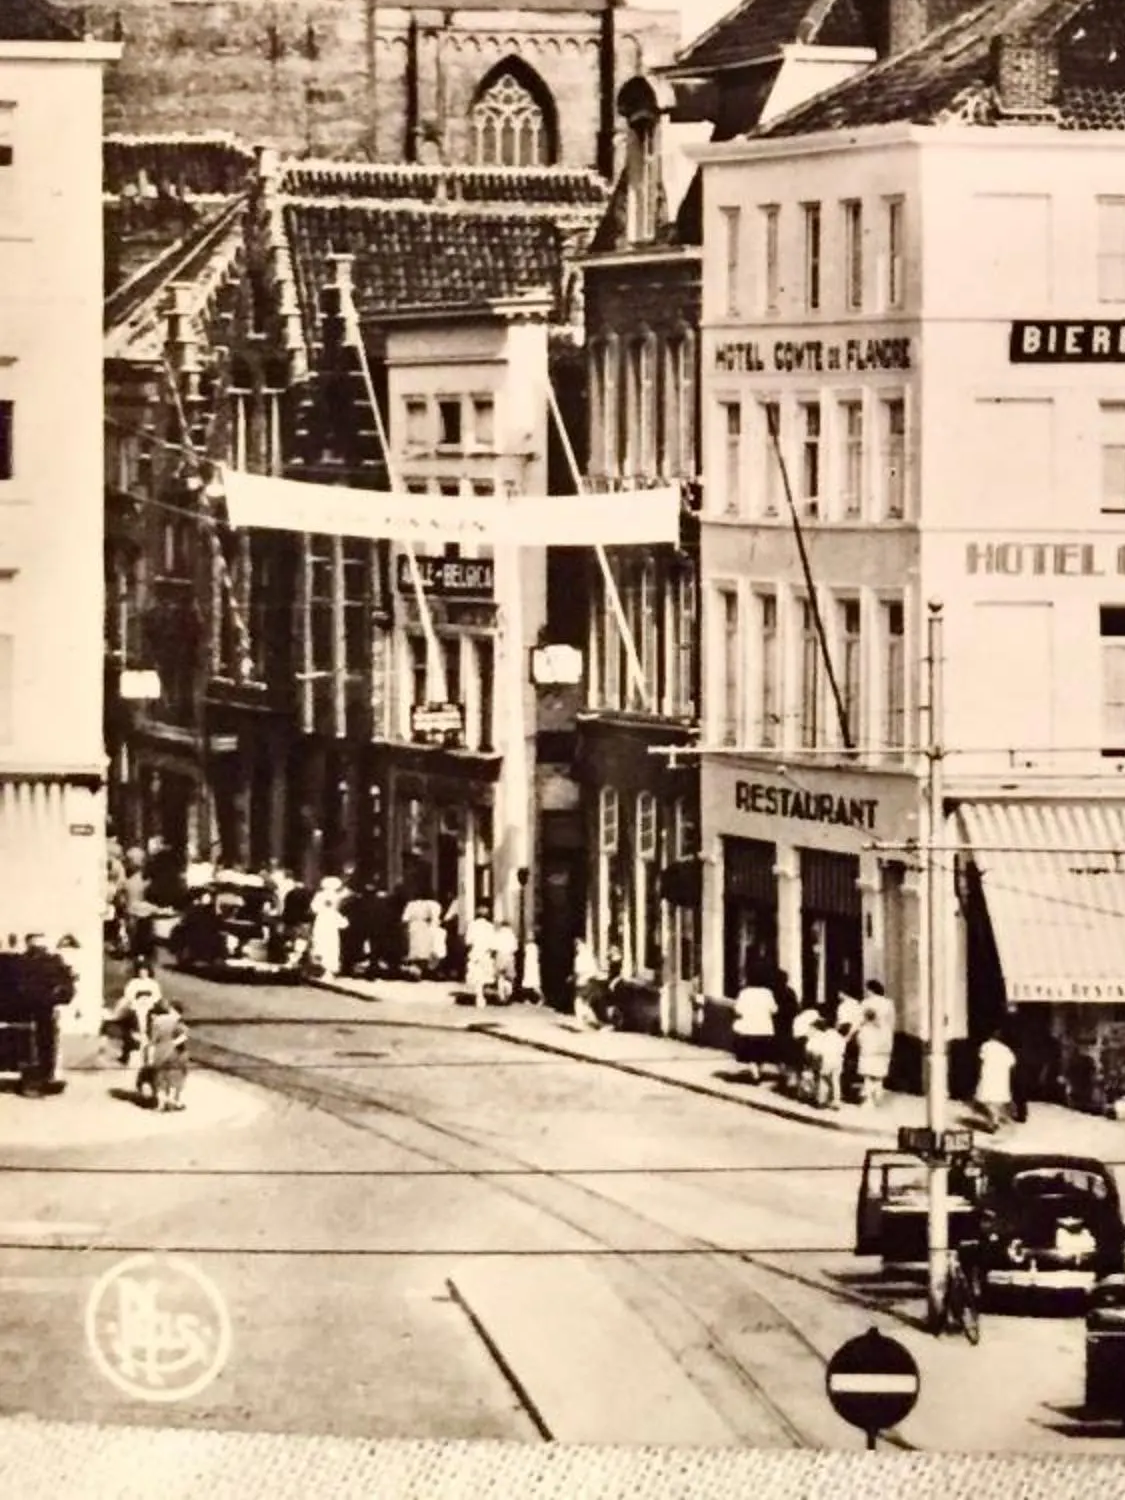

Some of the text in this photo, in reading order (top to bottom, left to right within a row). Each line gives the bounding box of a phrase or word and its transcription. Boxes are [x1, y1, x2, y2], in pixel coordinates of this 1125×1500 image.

[714, 341, 765, 372] HOTEL
[773, 340, 823, 372] COMTE
[846, 337, 911, 371] FLANDRE
[965, 542, 1106, 576] HOTEL
[735, 779, 879, 830] RESTAURANT
